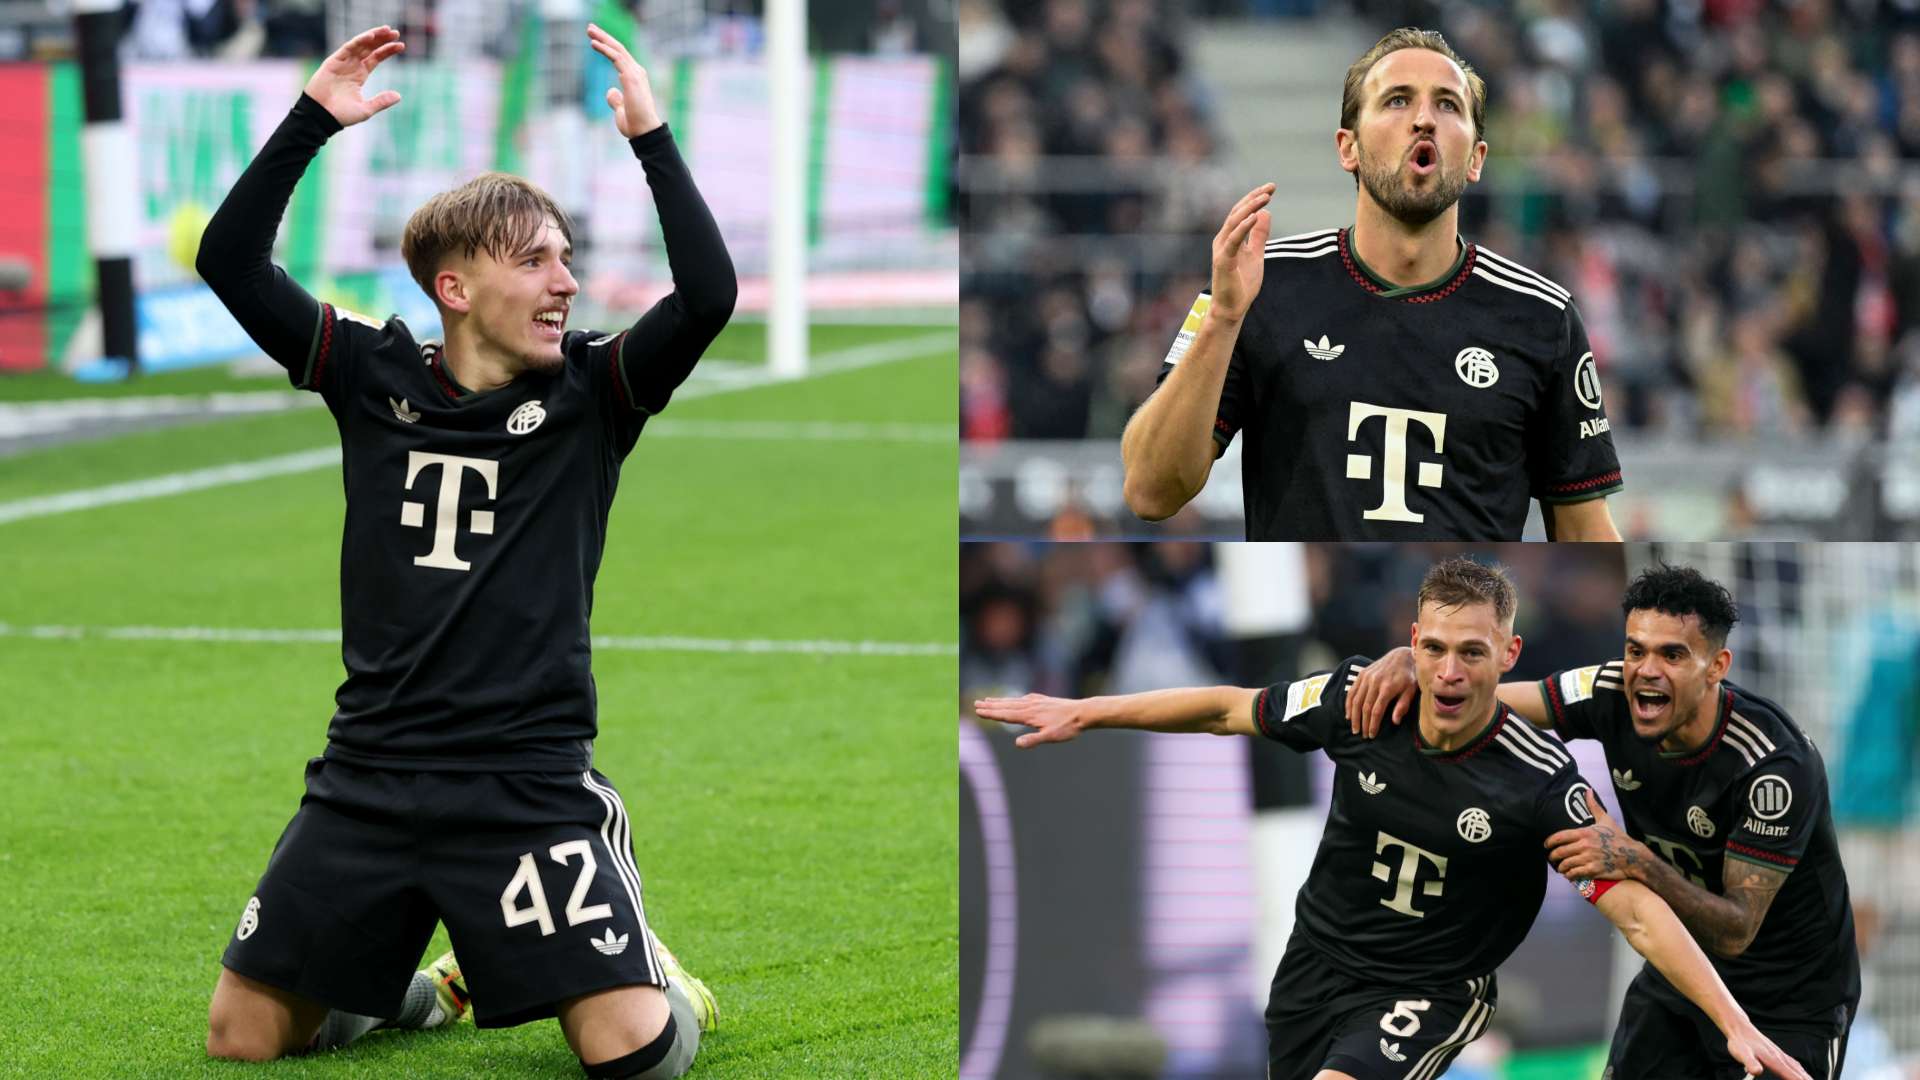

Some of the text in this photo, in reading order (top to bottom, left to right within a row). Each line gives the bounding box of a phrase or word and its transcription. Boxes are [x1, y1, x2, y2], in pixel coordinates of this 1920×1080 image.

[1346, 401, 1448, 524] T
[400, 450, 499, 571] T
[1743, 816, 1790, 837] Allianz
[500, 839, 613, 936] 42
[1371, 830, 1448, 918] T
[1380, 999, 1431, 1037] 6
